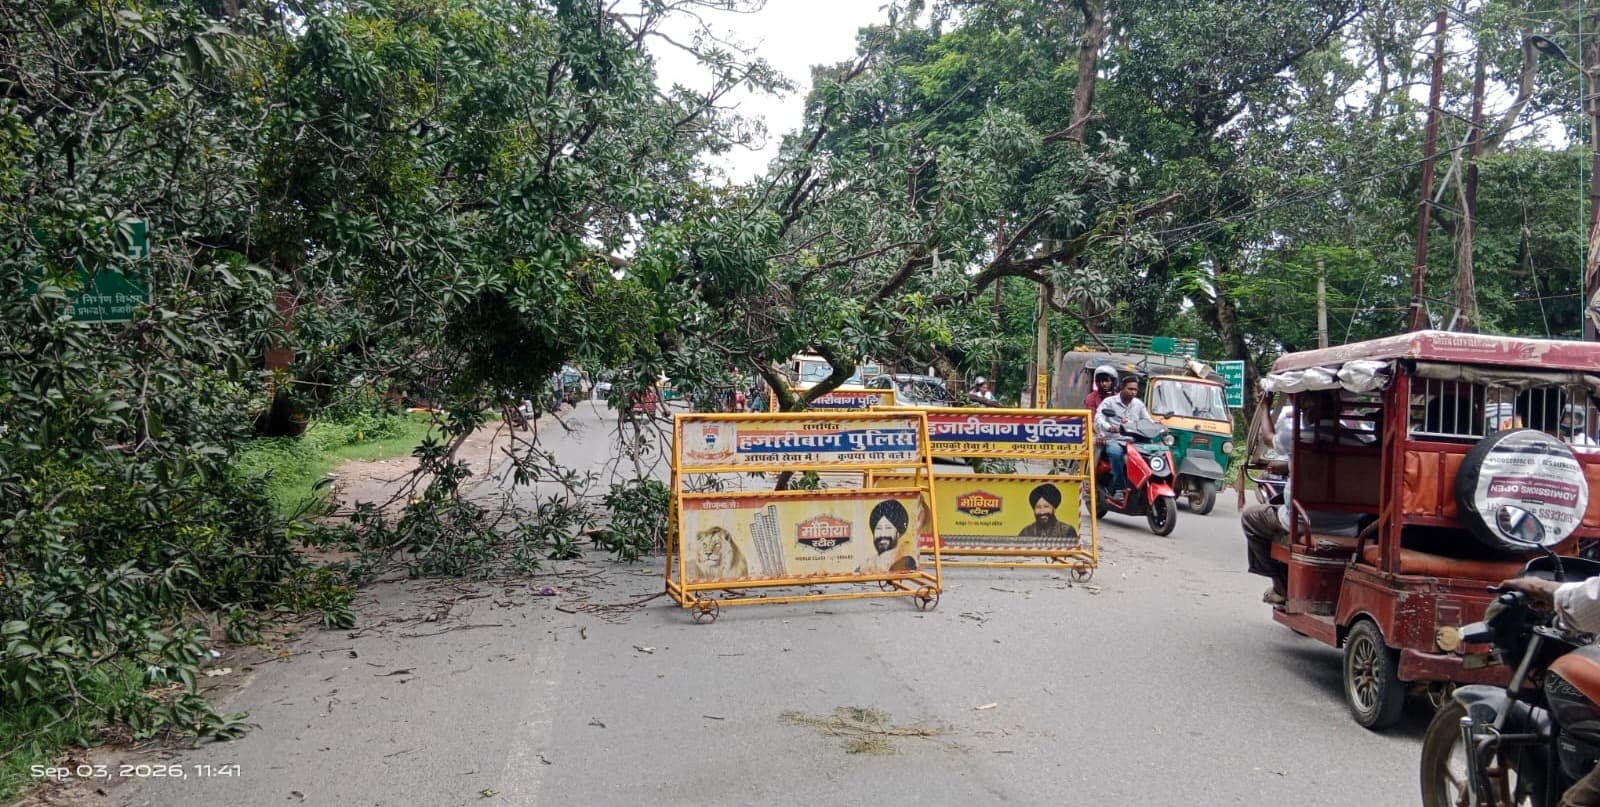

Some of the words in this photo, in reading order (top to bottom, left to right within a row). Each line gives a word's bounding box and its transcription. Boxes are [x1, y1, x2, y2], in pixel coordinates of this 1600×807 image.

[928, 418, 1020, 436] हजारीबाग
[1025, 419, 1081, 441] पुलिस
[740, 431, 843, 449] हजारीबाग
[848, 430, 916, 450] पुलिस
[744, 453, 779, 462] आपकी
[782, 453, 802, 462] सेवा
[837, 453, 866, 461] कृपया
[1490, 484, 1519, 493] OPEN
[1521, 485, 1576, 501] ADMISSIONS
[1538, 508, 1574, 523] SUCCESS
[812, 538, 836, 548] स्टील
